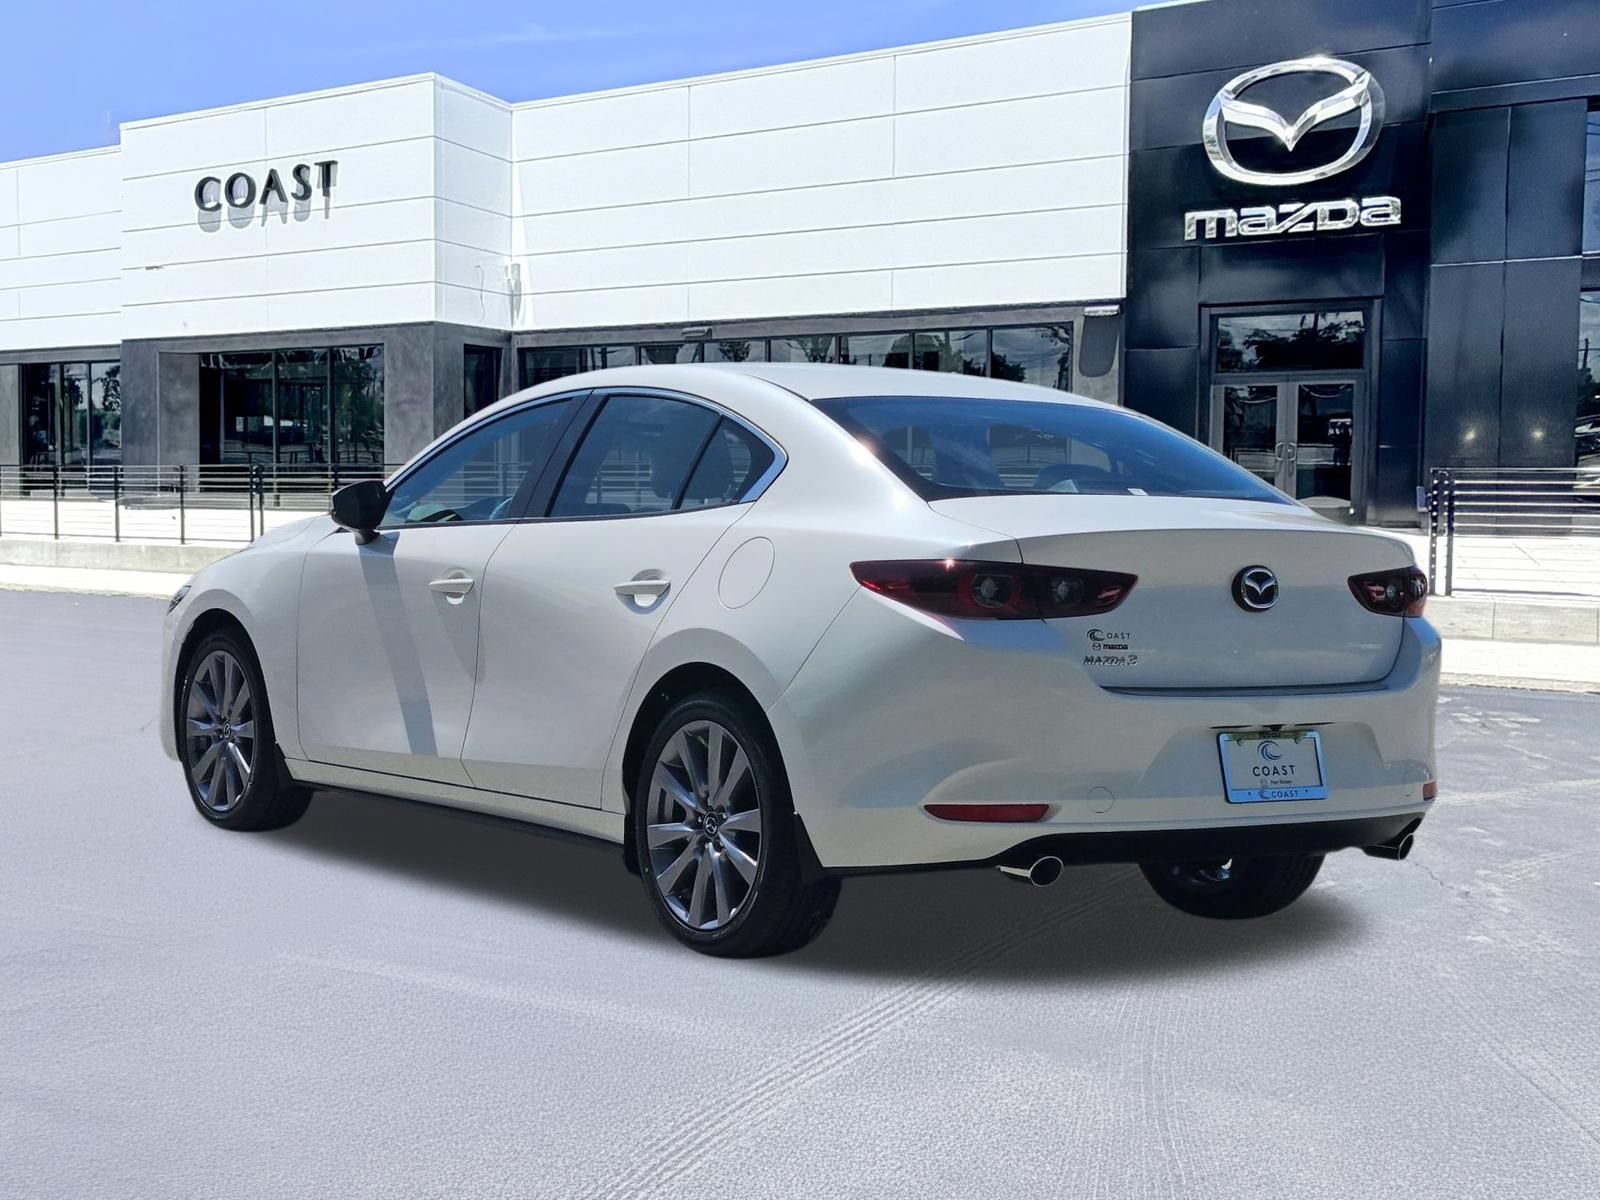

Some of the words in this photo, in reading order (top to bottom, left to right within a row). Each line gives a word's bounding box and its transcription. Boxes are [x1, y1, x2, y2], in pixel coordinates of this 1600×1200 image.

[194, 160, 339, 212] COAST
[1184, 195, 1402, 241] mazda
[1252, 765, 1295, 777] COAST
[1271, 790, 1299, 798] COAST
